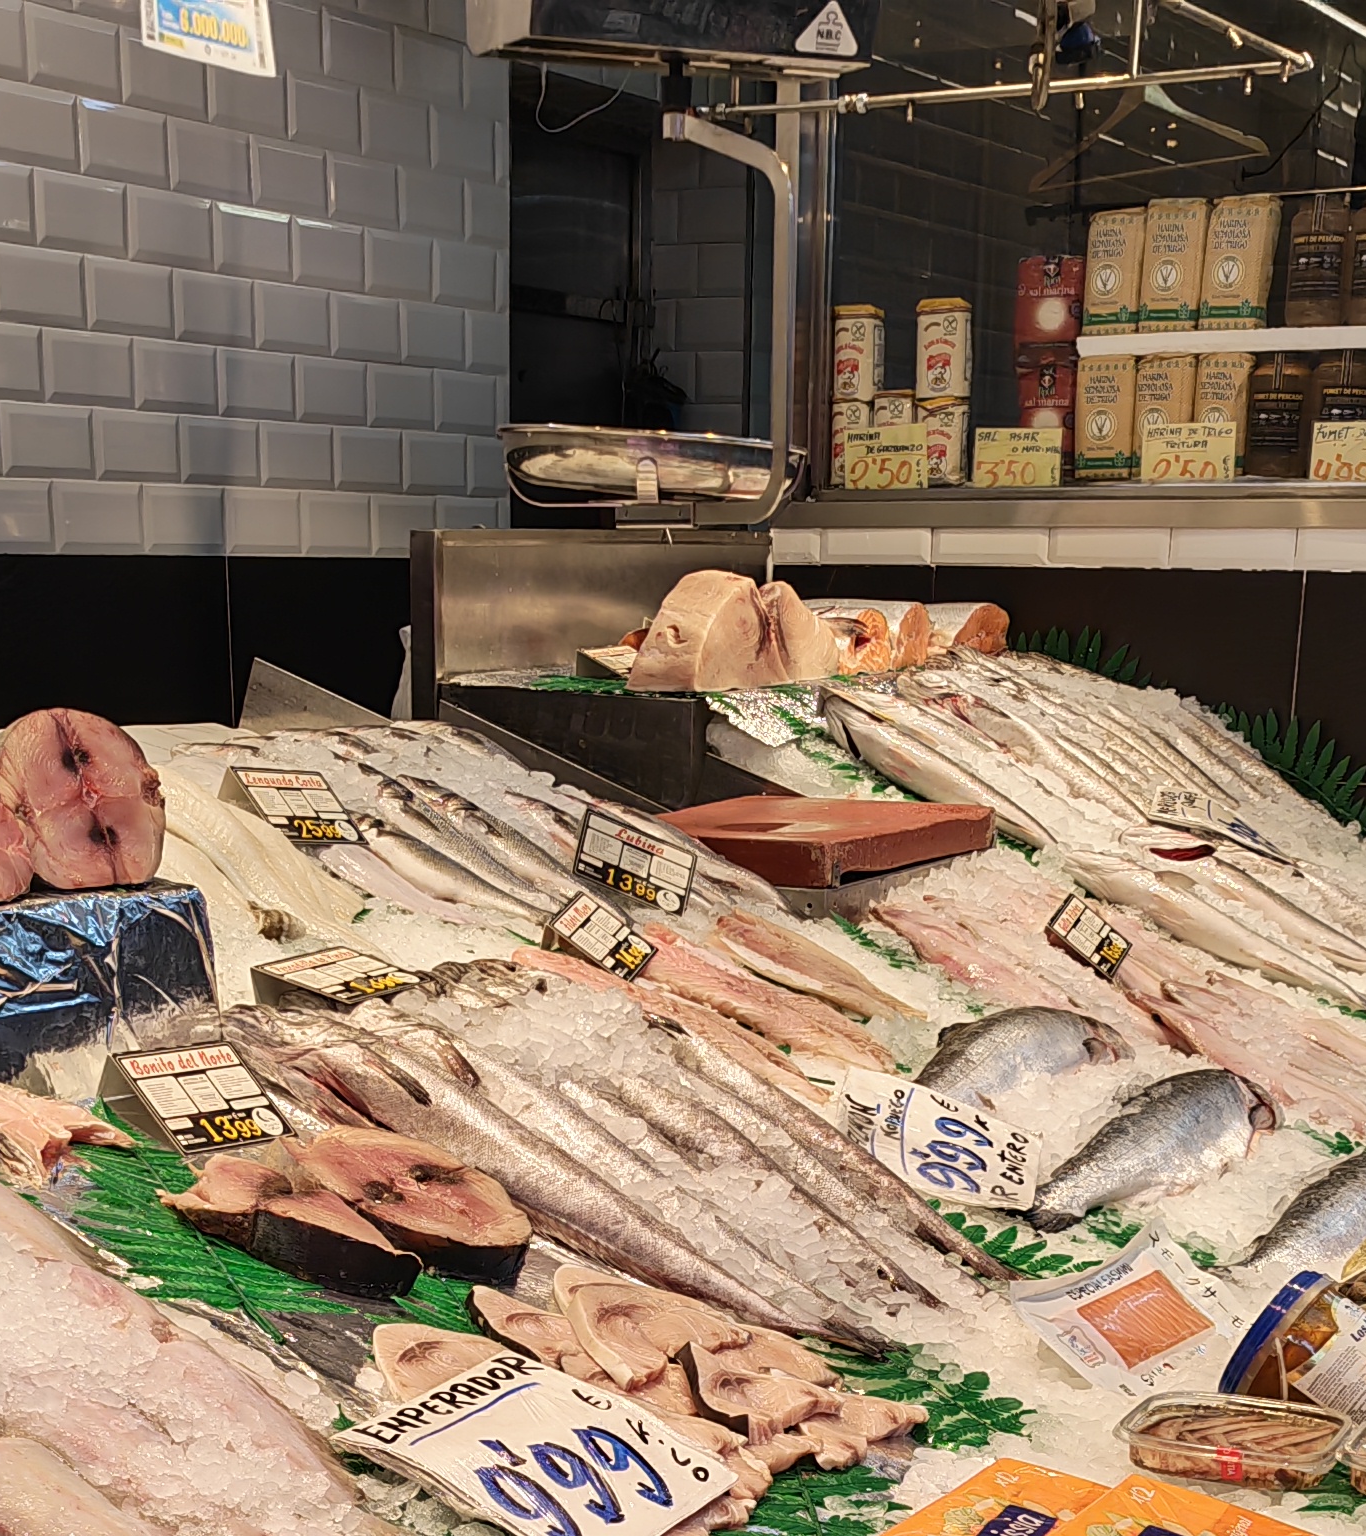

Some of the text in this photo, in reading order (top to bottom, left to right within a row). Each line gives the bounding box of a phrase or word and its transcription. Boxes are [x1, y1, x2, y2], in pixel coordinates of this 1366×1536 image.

[179, 7, 249, 48] 6.000.000
[1202, 426, 1233, 437] TRIGO
[614, 828, 665, 856] Lubina
[130, 1048, 235, 1076] Bonito del Norte
[997, 1131, 1030, 1186] ENTERO
[1149, 1229, 1248, 1329] スモークサーモ
[355, 1354, 545, 1445] EMPERADOR
